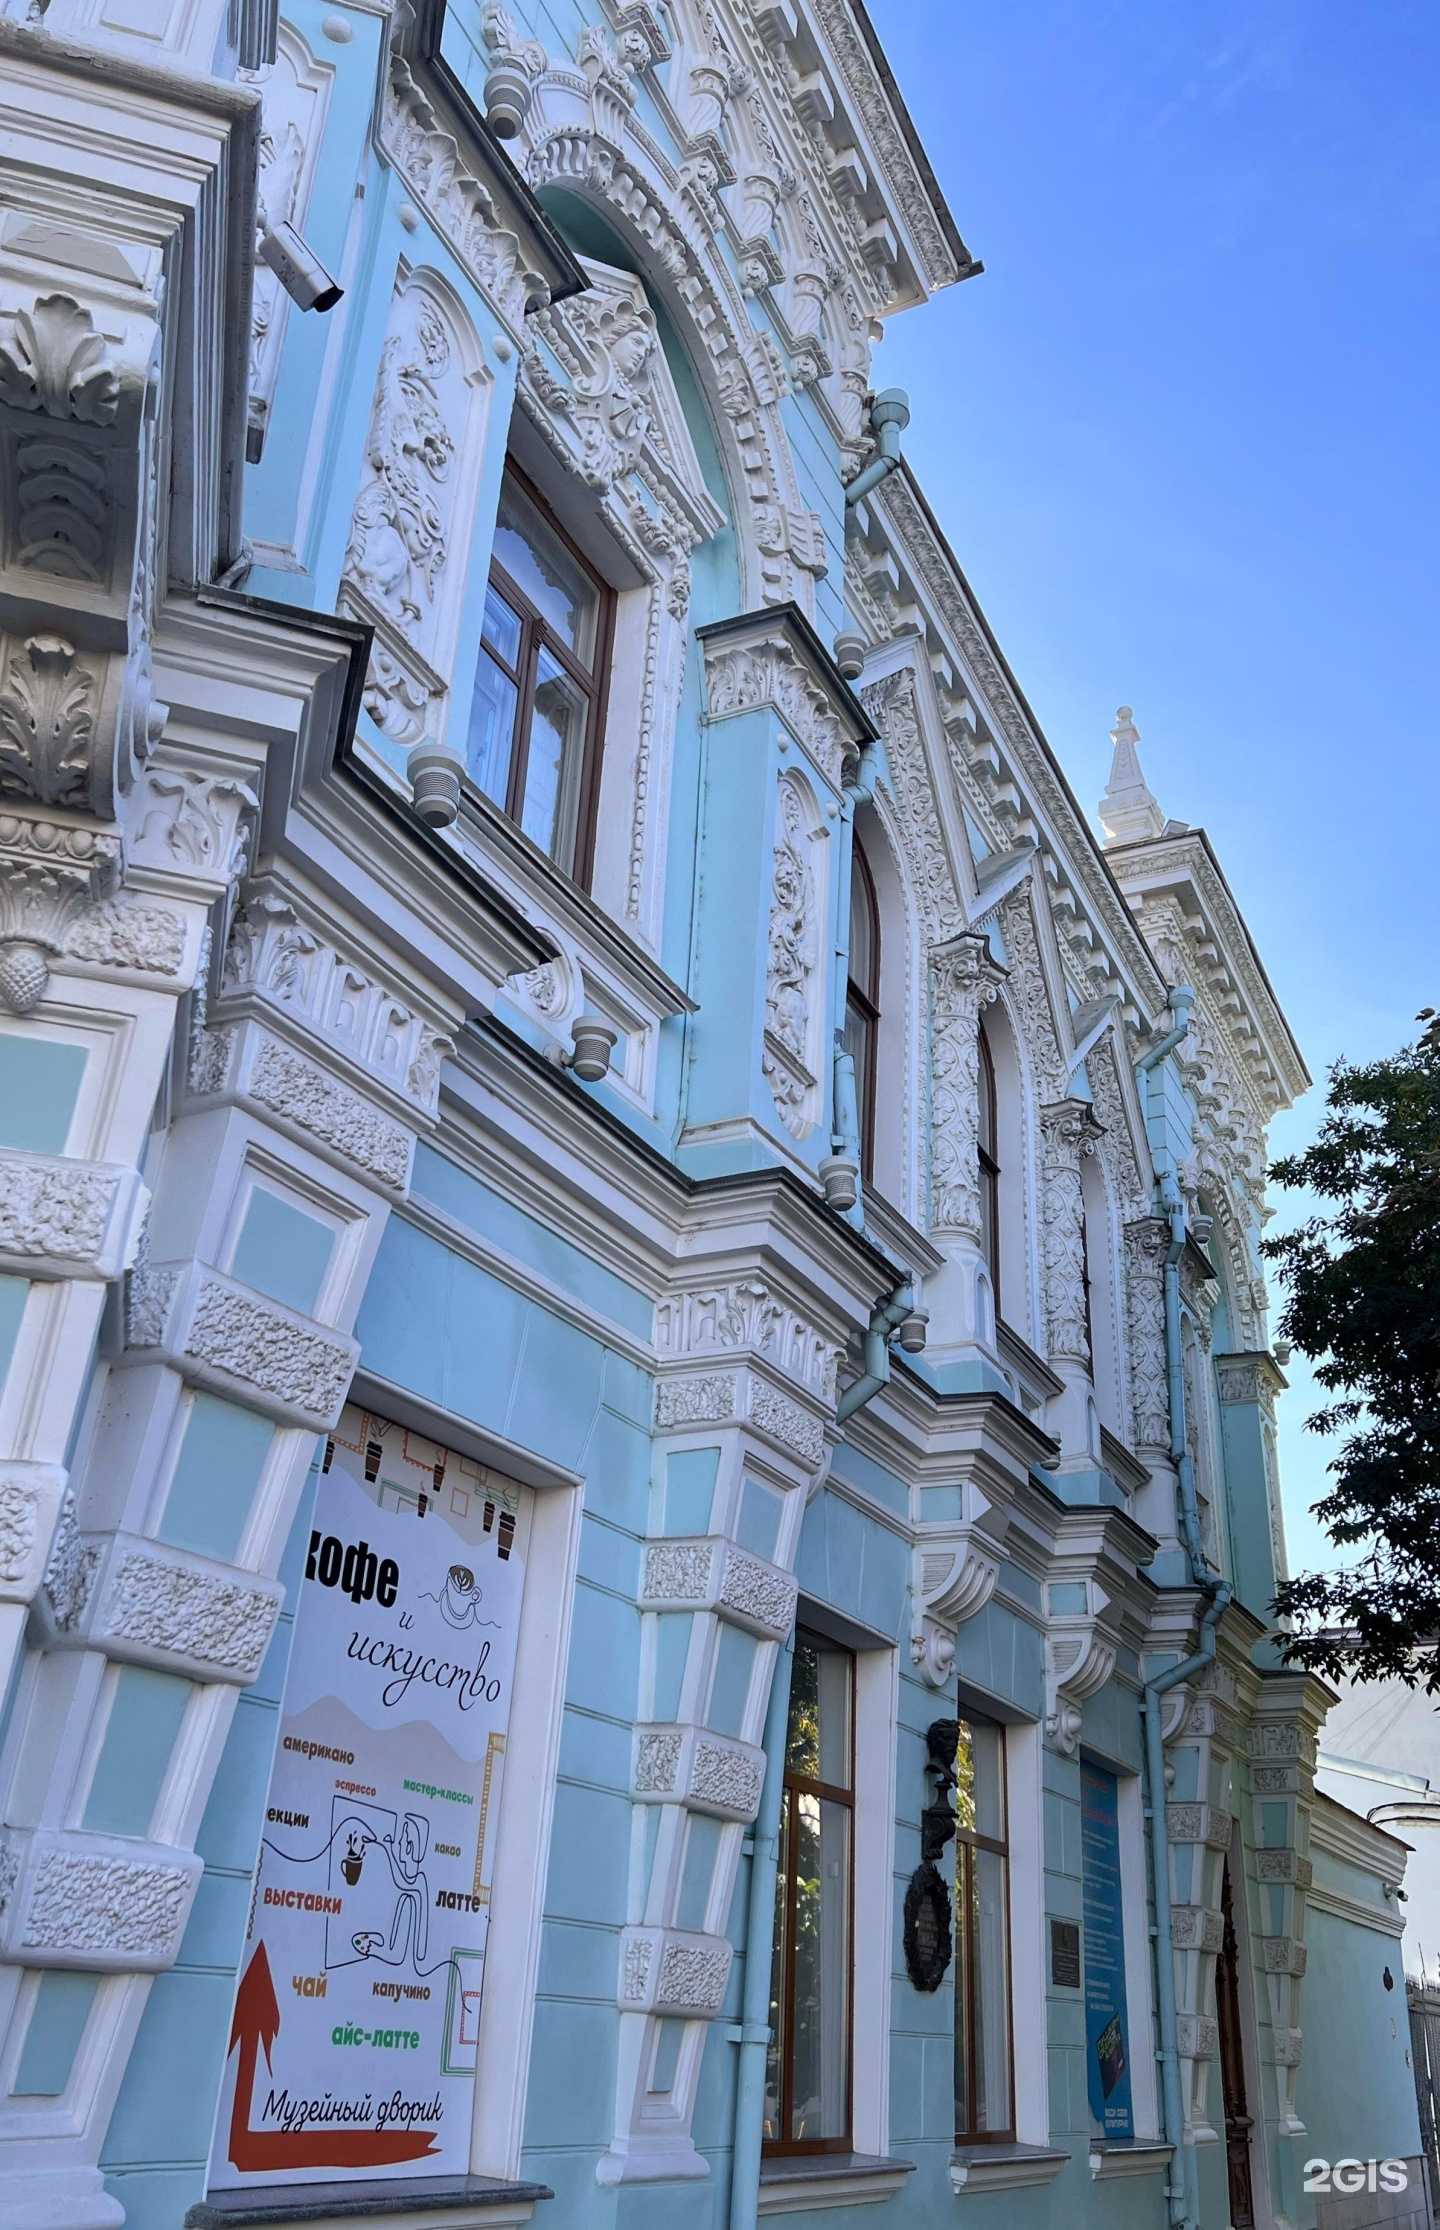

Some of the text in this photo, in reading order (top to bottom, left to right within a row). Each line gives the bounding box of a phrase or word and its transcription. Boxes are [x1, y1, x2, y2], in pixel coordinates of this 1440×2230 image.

[400, 1611, 416, 1630] и
[347, 1631, 501, 1710] искусство
[283, 1736, 355, 1765] американо
[335, 1779, 377, 1797] эспрессо
[403, 1779, 474, 1805] мастер-классы
[266, 1807, 310, 1829] екции
[263, 1887, 343, 1915] выставки
[435, 1889, 481, 1913] латте
[292, 1972, 328, 1998] чай
[372, 1980, 431, 2002] капучино
[331, 2021, 420, 2049] айс-латте
[262, 2088, 444, 2134] Музейный дворик
